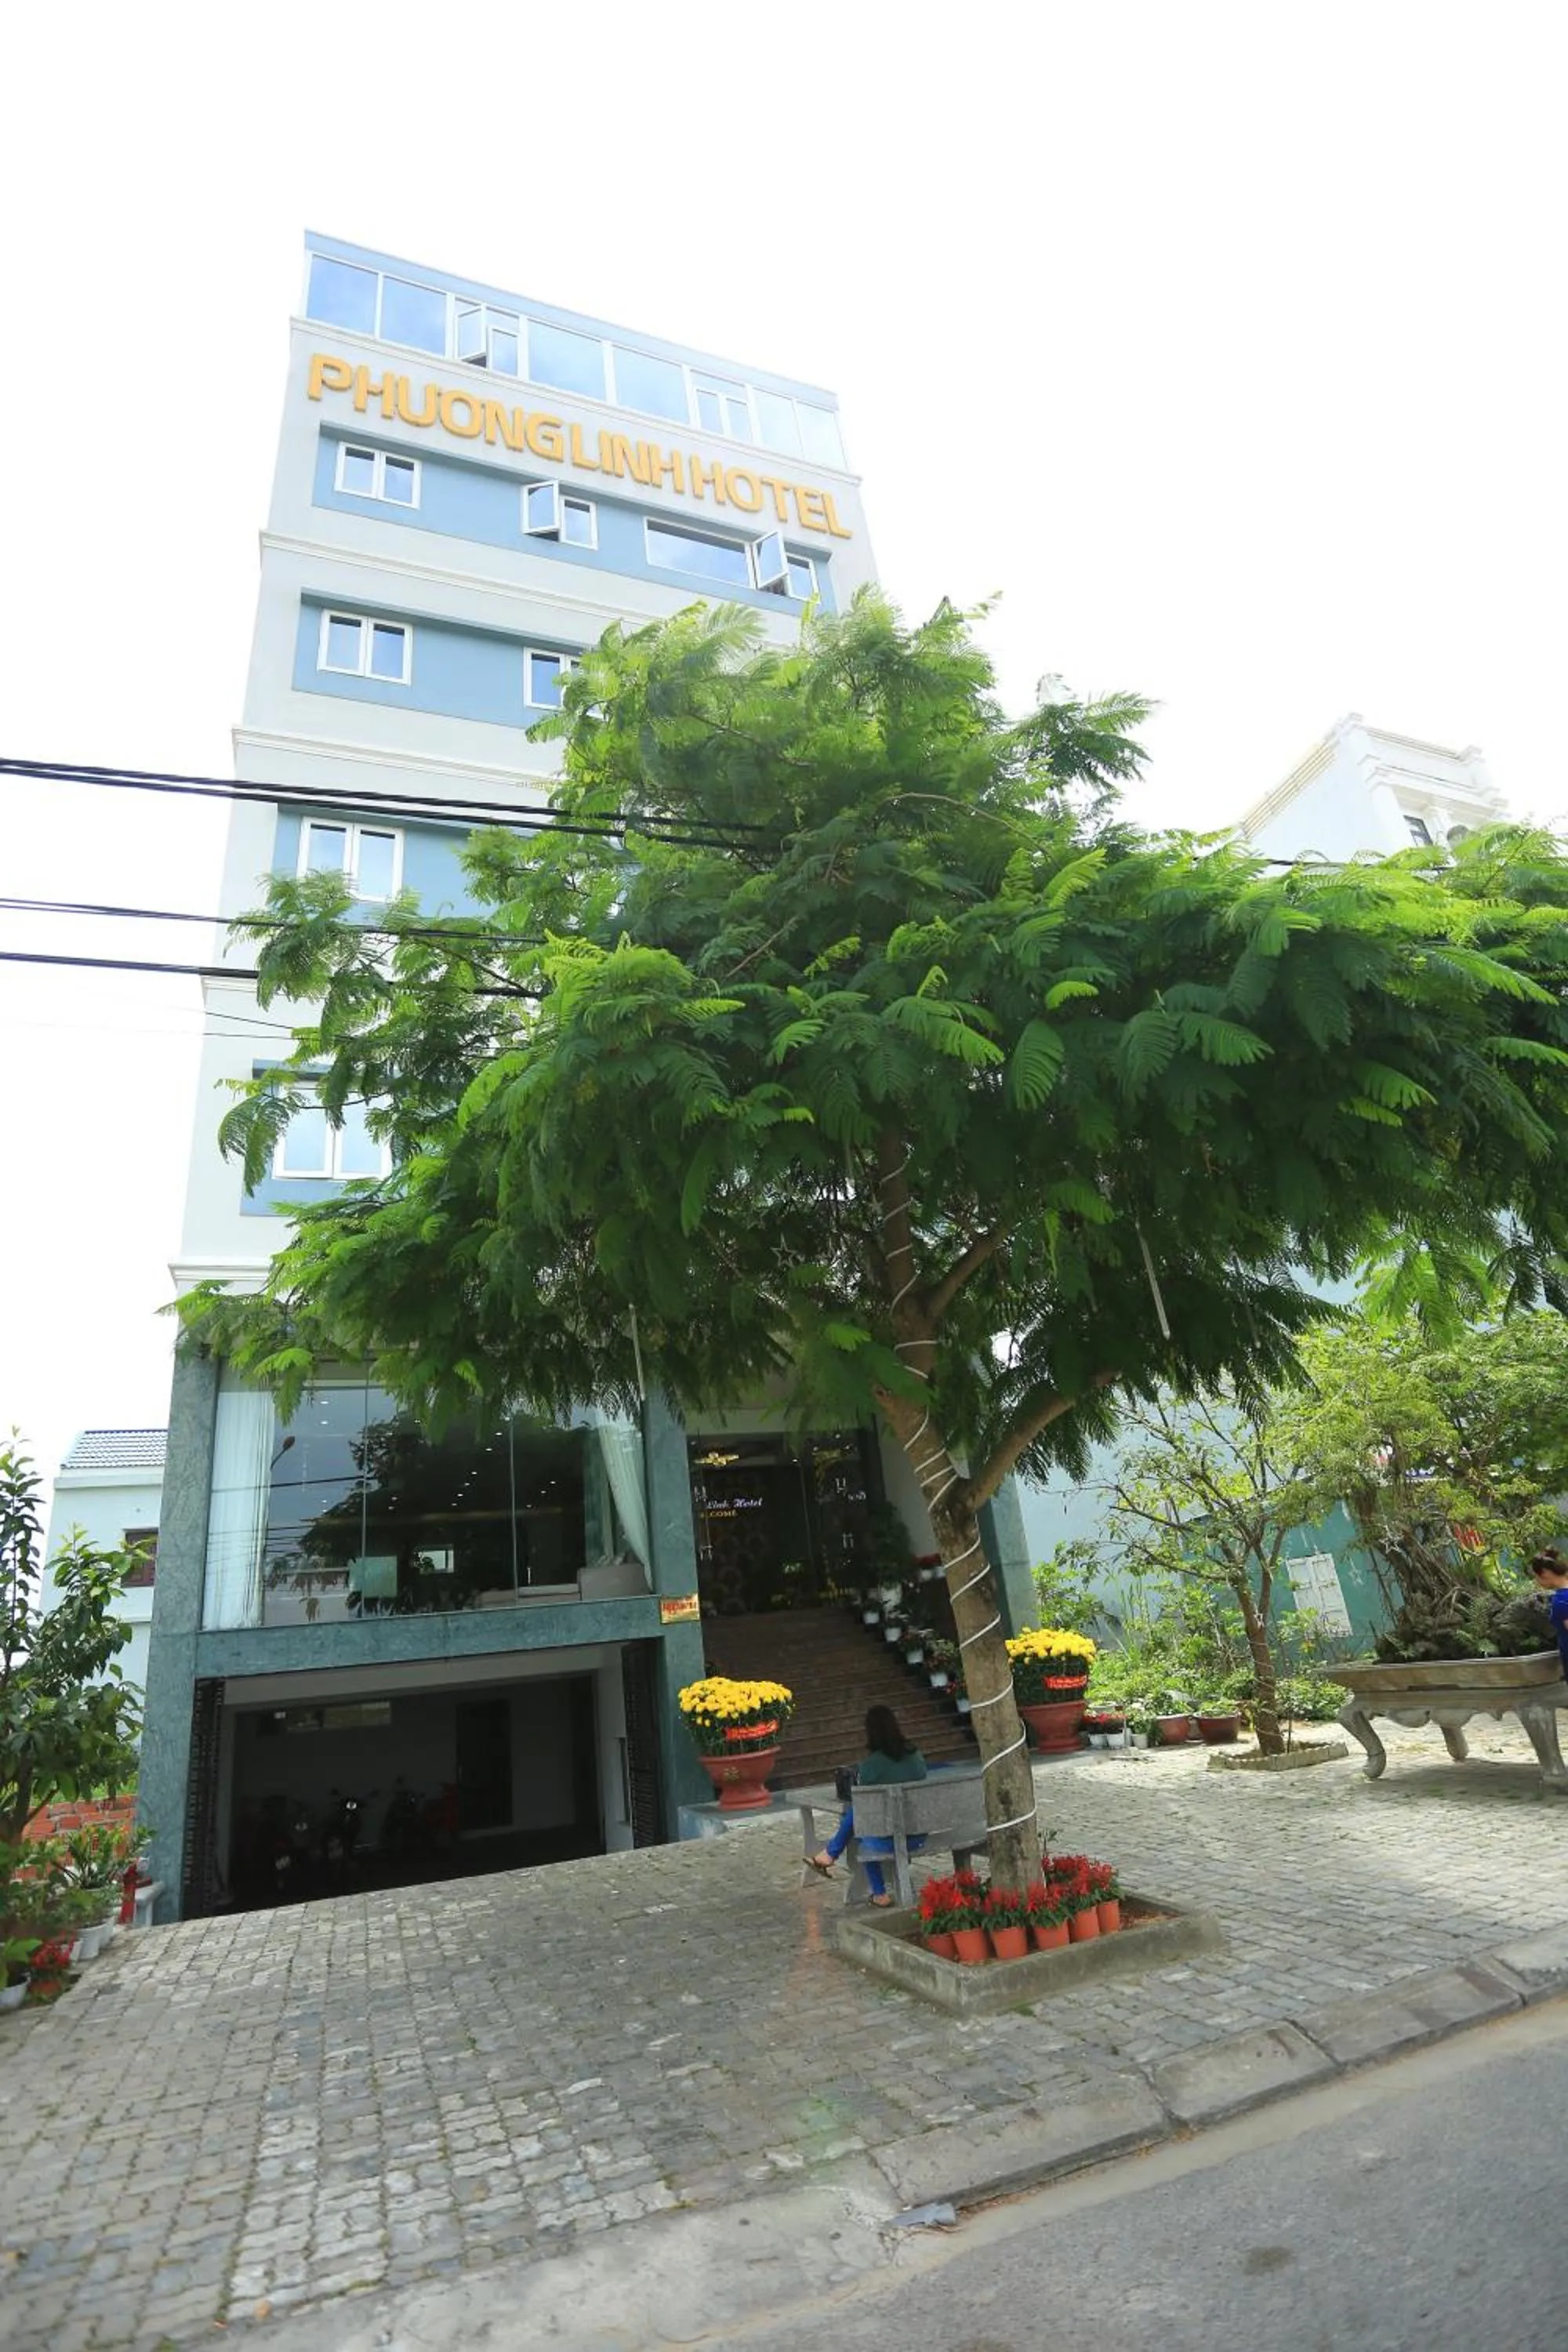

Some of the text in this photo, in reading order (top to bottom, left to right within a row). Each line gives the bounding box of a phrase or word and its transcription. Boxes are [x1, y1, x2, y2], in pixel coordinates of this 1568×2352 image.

[308, 352, 853, 539] PHUONG LINH HOTEL
